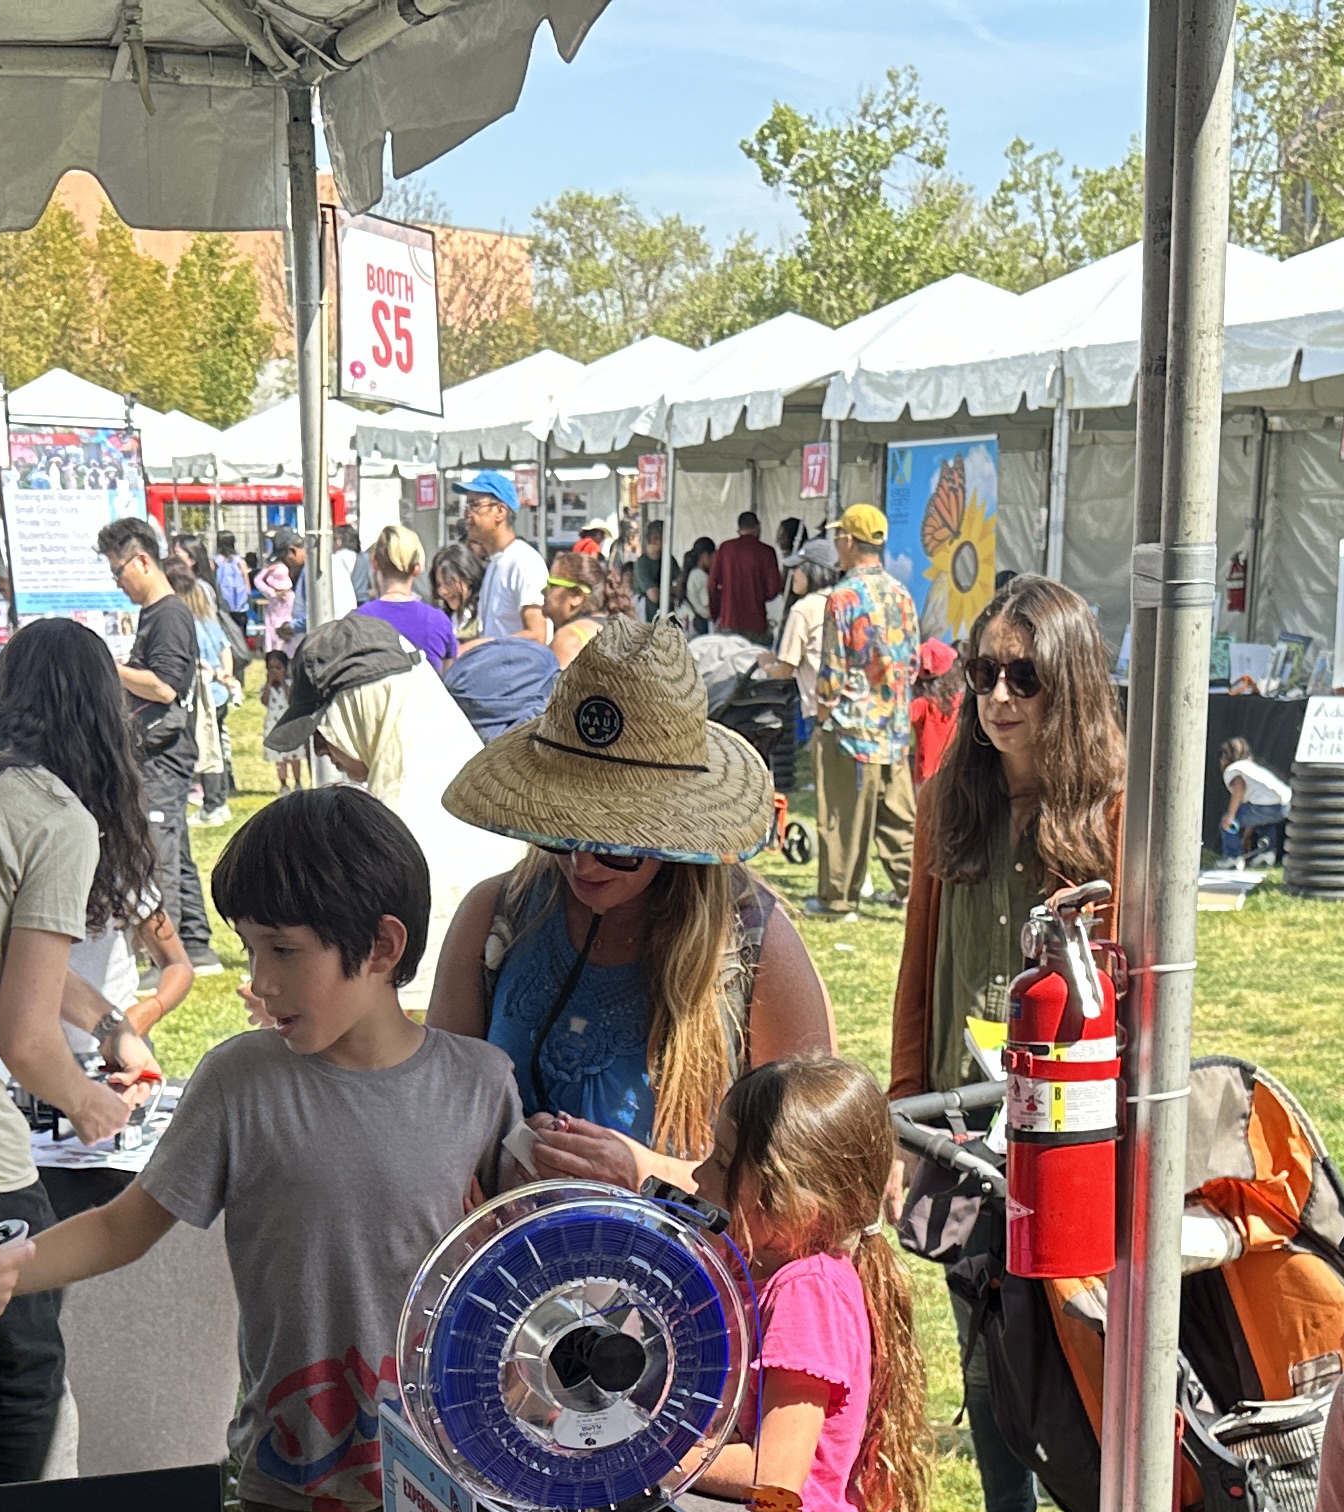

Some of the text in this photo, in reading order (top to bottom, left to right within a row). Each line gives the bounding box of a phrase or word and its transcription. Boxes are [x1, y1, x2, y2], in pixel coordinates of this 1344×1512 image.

[366, 262, 414, 303] BOOTH
[372, 299, 414, 374] S5
[581, 715, 618, 728] MAUI
[1055, 1086, 1061, 1101] B
